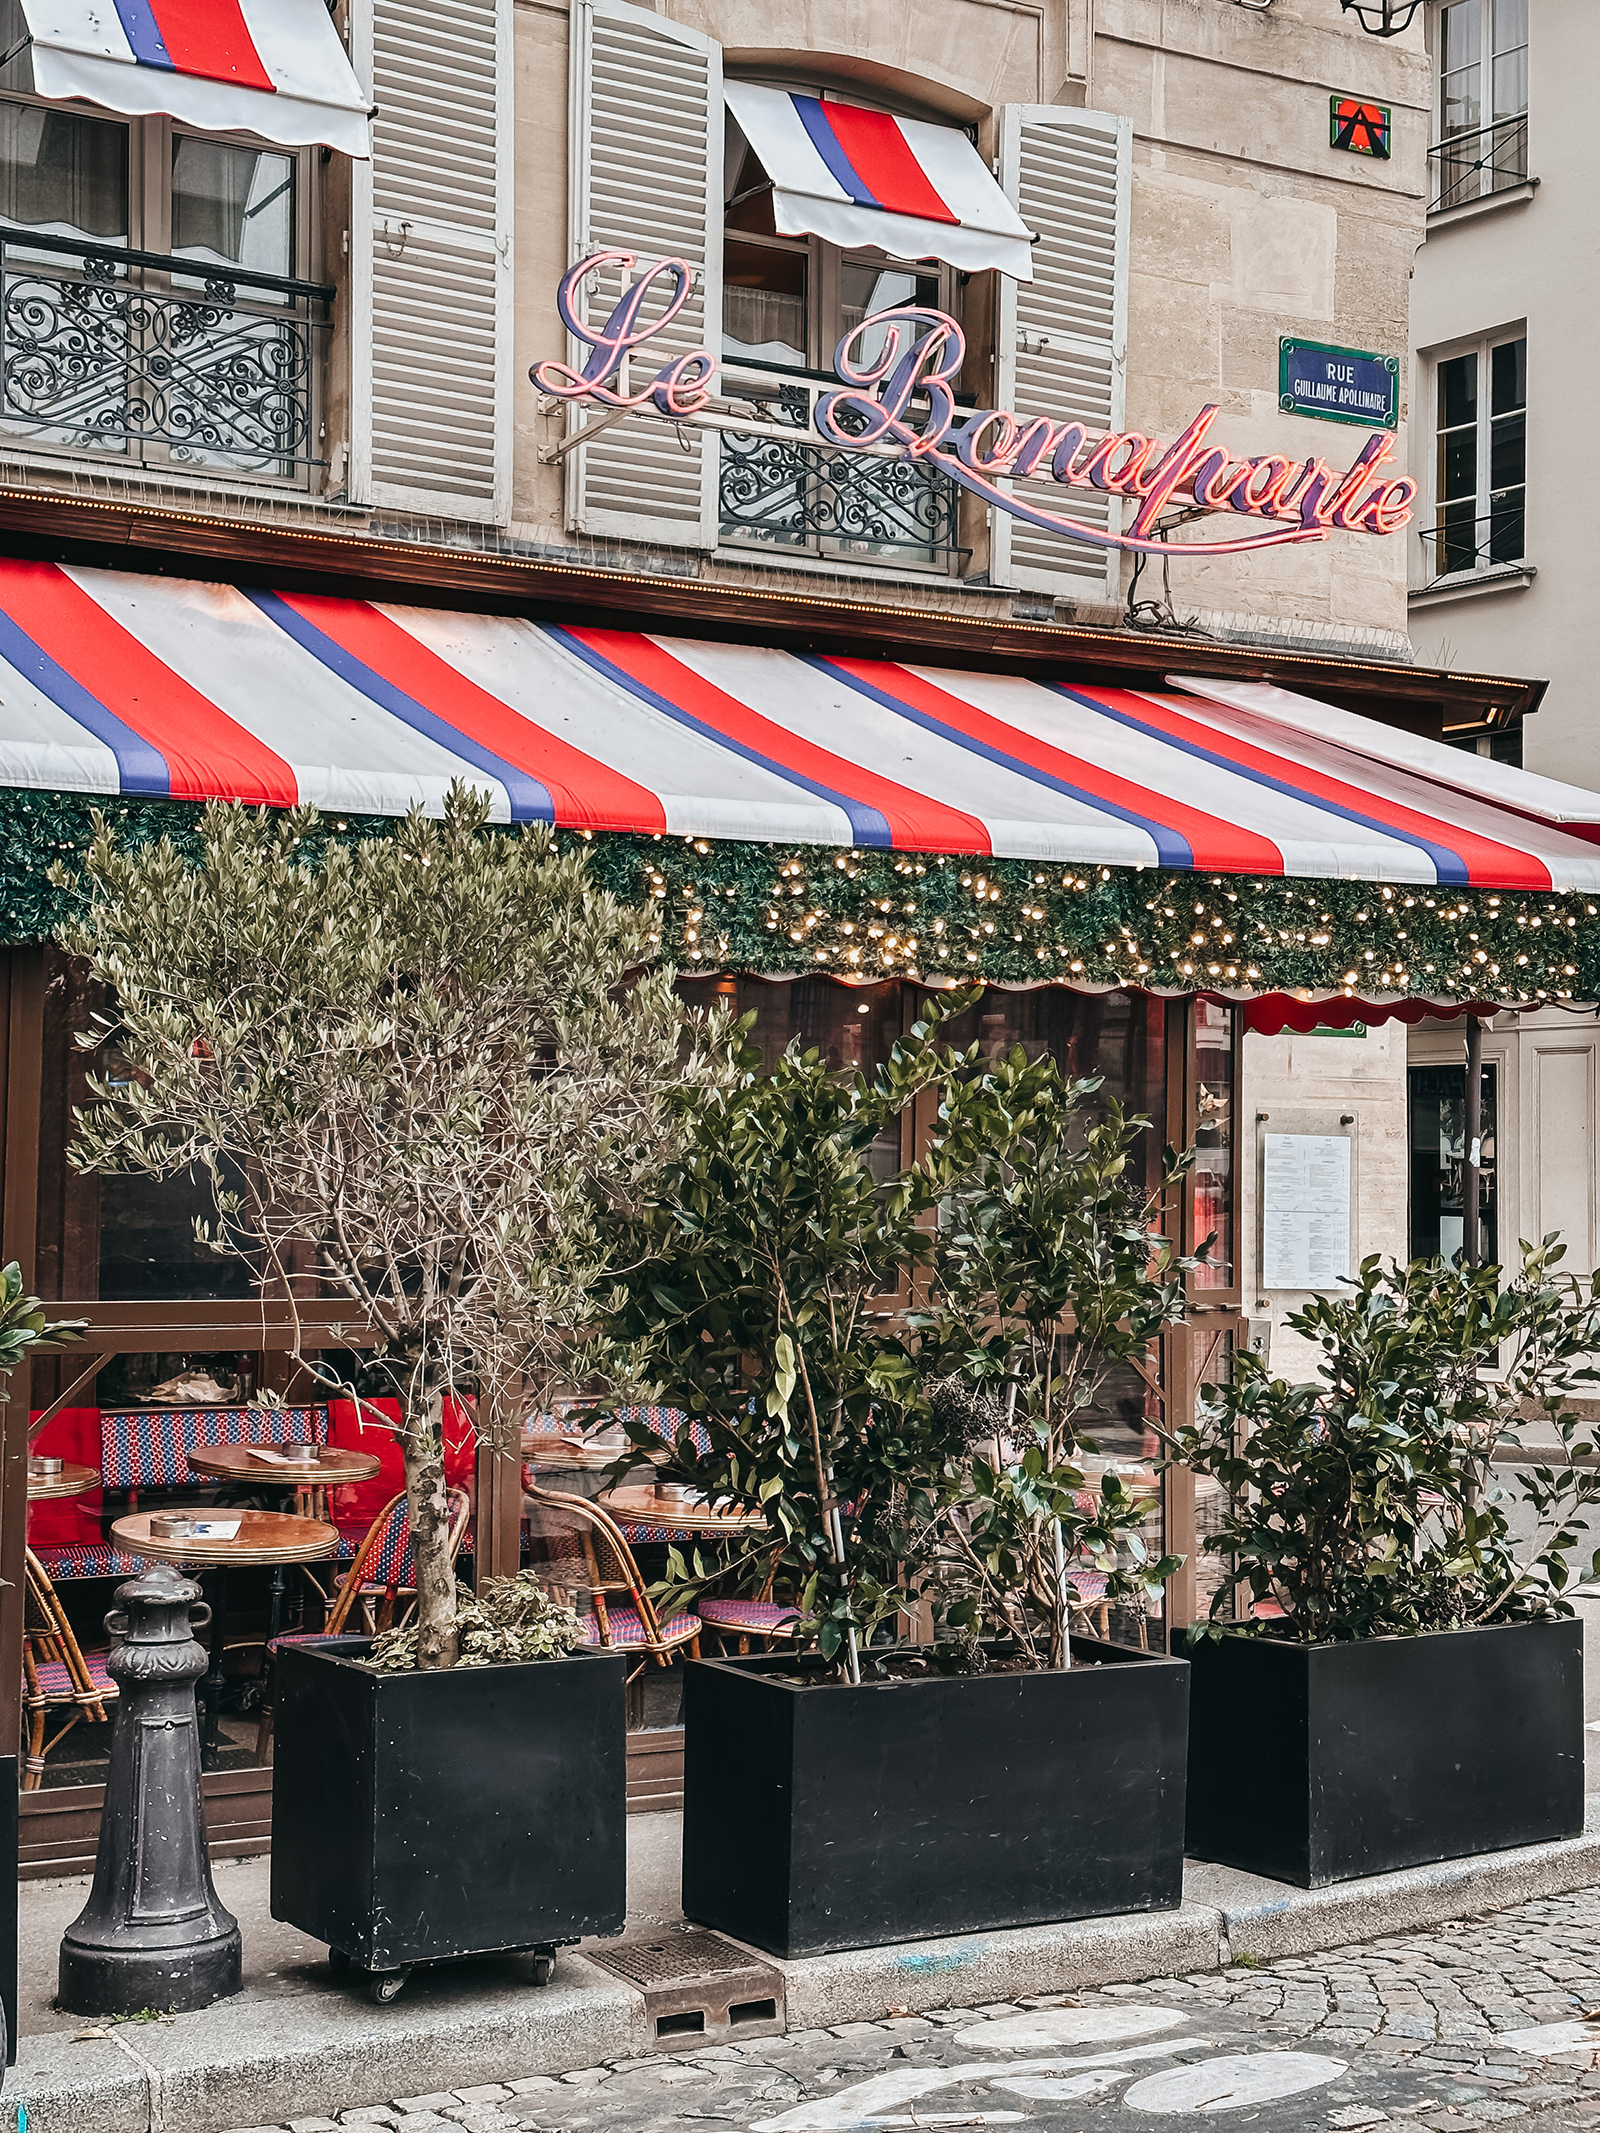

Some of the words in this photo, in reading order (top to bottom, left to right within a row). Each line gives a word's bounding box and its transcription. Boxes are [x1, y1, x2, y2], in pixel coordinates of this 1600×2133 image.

[1327, 363, 1354, 383] RUE
[528, 250, 717, 417] Le
[814, 305, 1419, 555] Bonaparte
[1295, 379, 1337, 402] GUILLAUME
[1339, 387, 1386, 411] APOLLINAIRE
